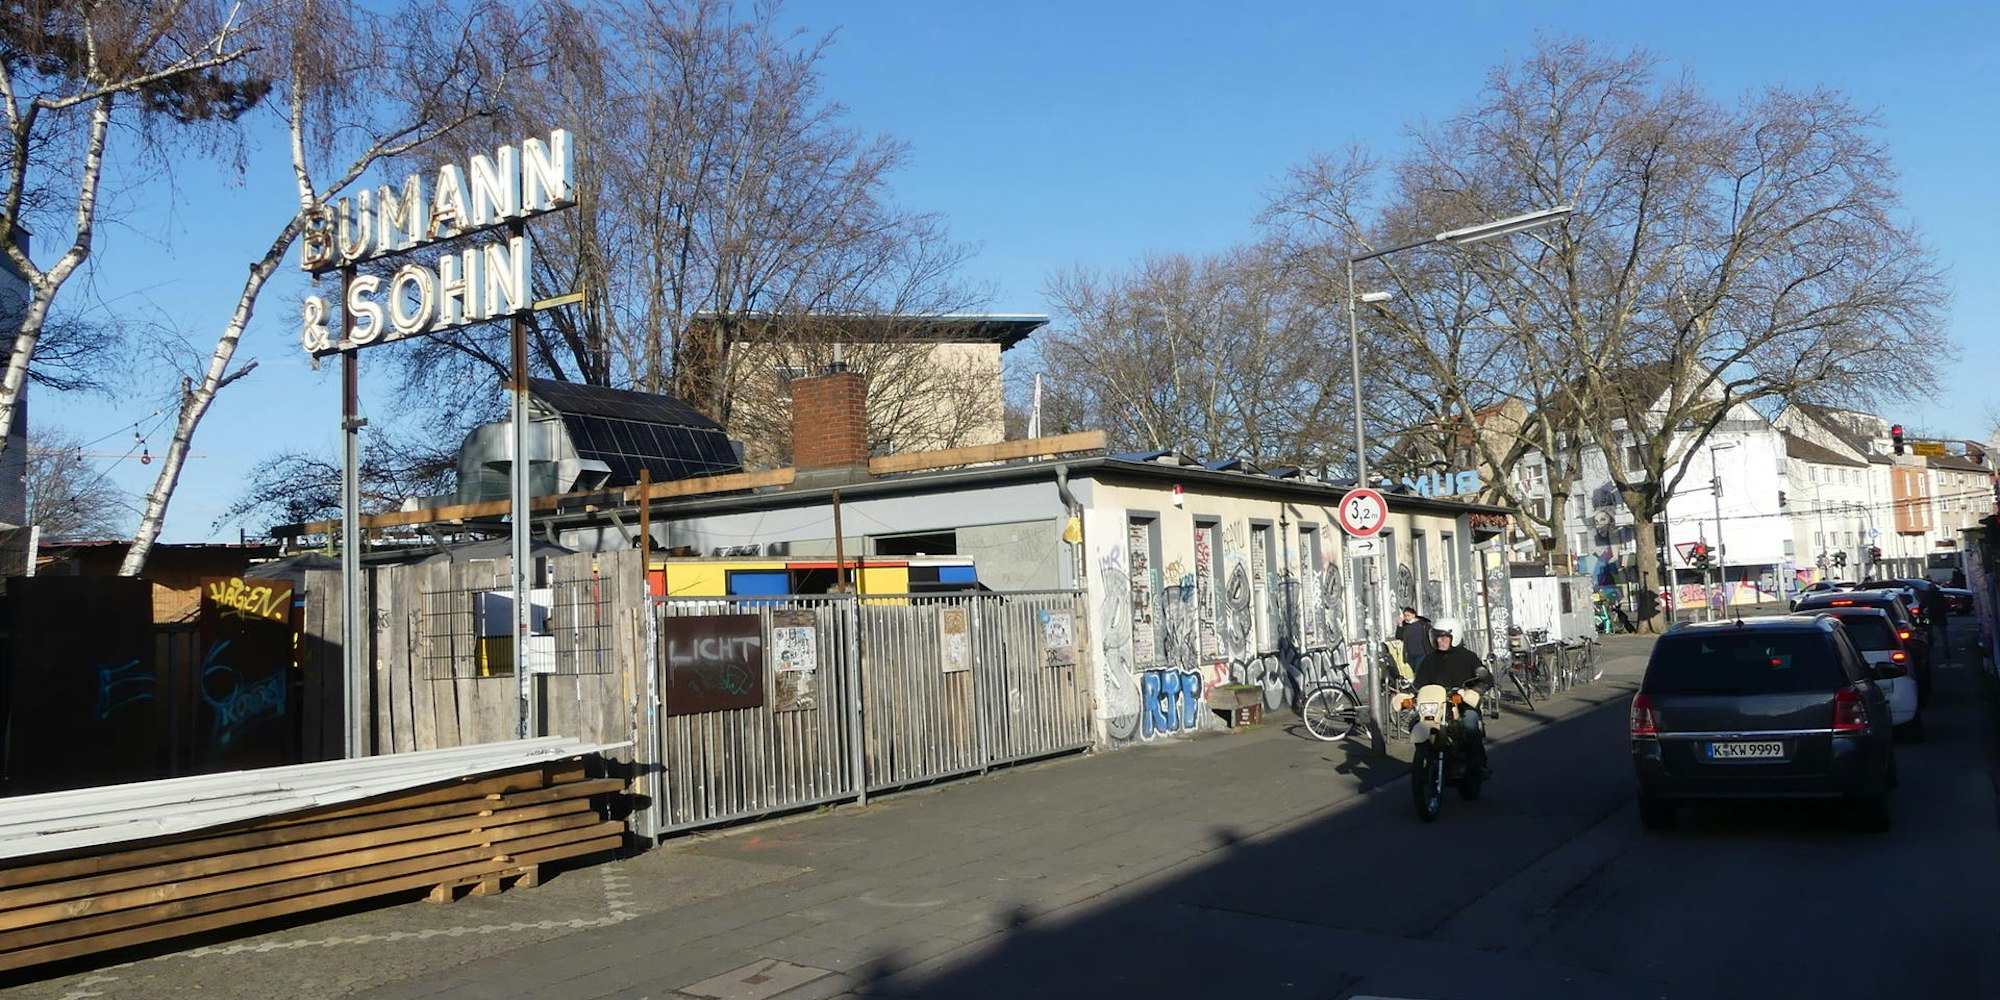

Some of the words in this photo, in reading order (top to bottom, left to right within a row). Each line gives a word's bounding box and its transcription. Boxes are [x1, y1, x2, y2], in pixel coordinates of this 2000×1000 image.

[302, 129, 573, 271] BUMANN
[303, 296, 333, 353] &
[348, 237, 532, 345] SOHN
[1351, 500, 1370, 524] 3,2
[669, 635, 761, 665] LICHT
[1713, 745, 1722, 756] K
[1730, 744, 1746, 756] KW
[1749, 744, 1781, 755] 9999
